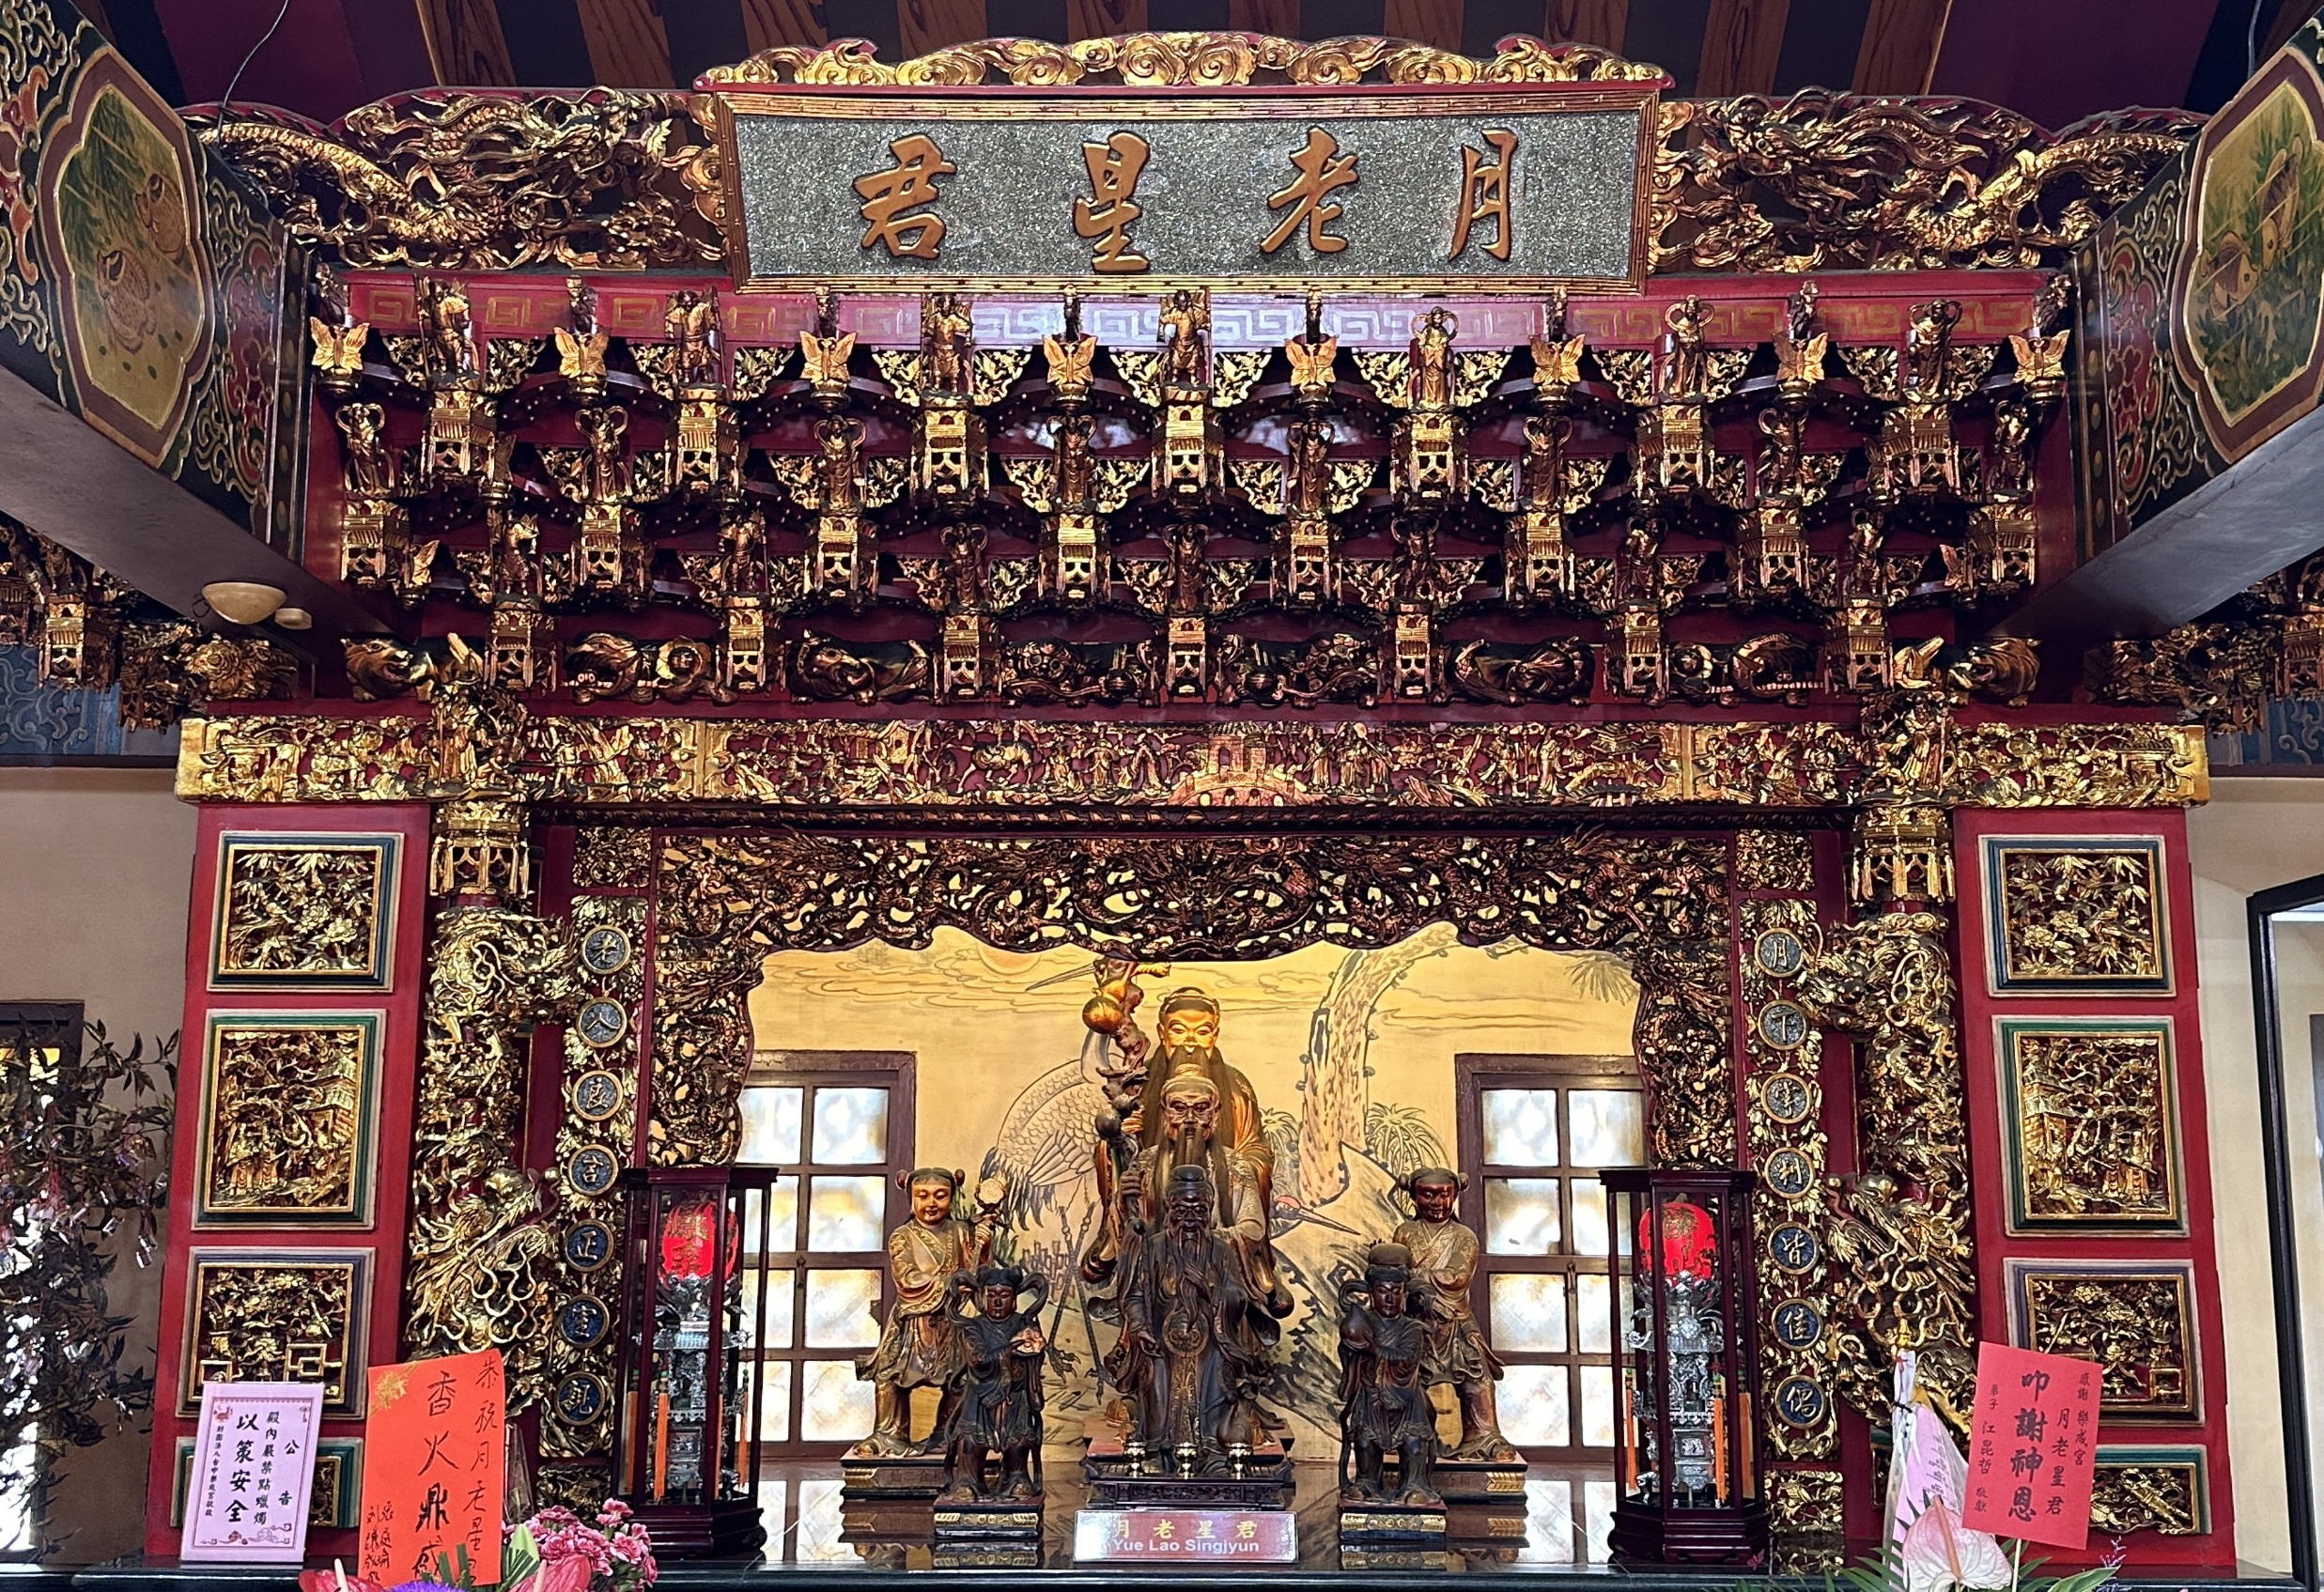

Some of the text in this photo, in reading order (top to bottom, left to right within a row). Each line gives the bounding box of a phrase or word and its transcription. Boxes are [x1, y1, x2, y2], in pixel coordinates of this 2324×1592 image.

[852, 128, 1519, 271] 月老星君
[225, 1414, 259, 1522] 以策安全
[278, 1439, 300, 1506] 公告
[2008, 1369, 2050, 1522] 叩謝神恩
[2045, 1408, 2069, 1515] 月老星君
[1113, 1538, 1259, 1554] Yue Lao Singjyun
[1115, 1519, 1258, 1539] 月老星君
